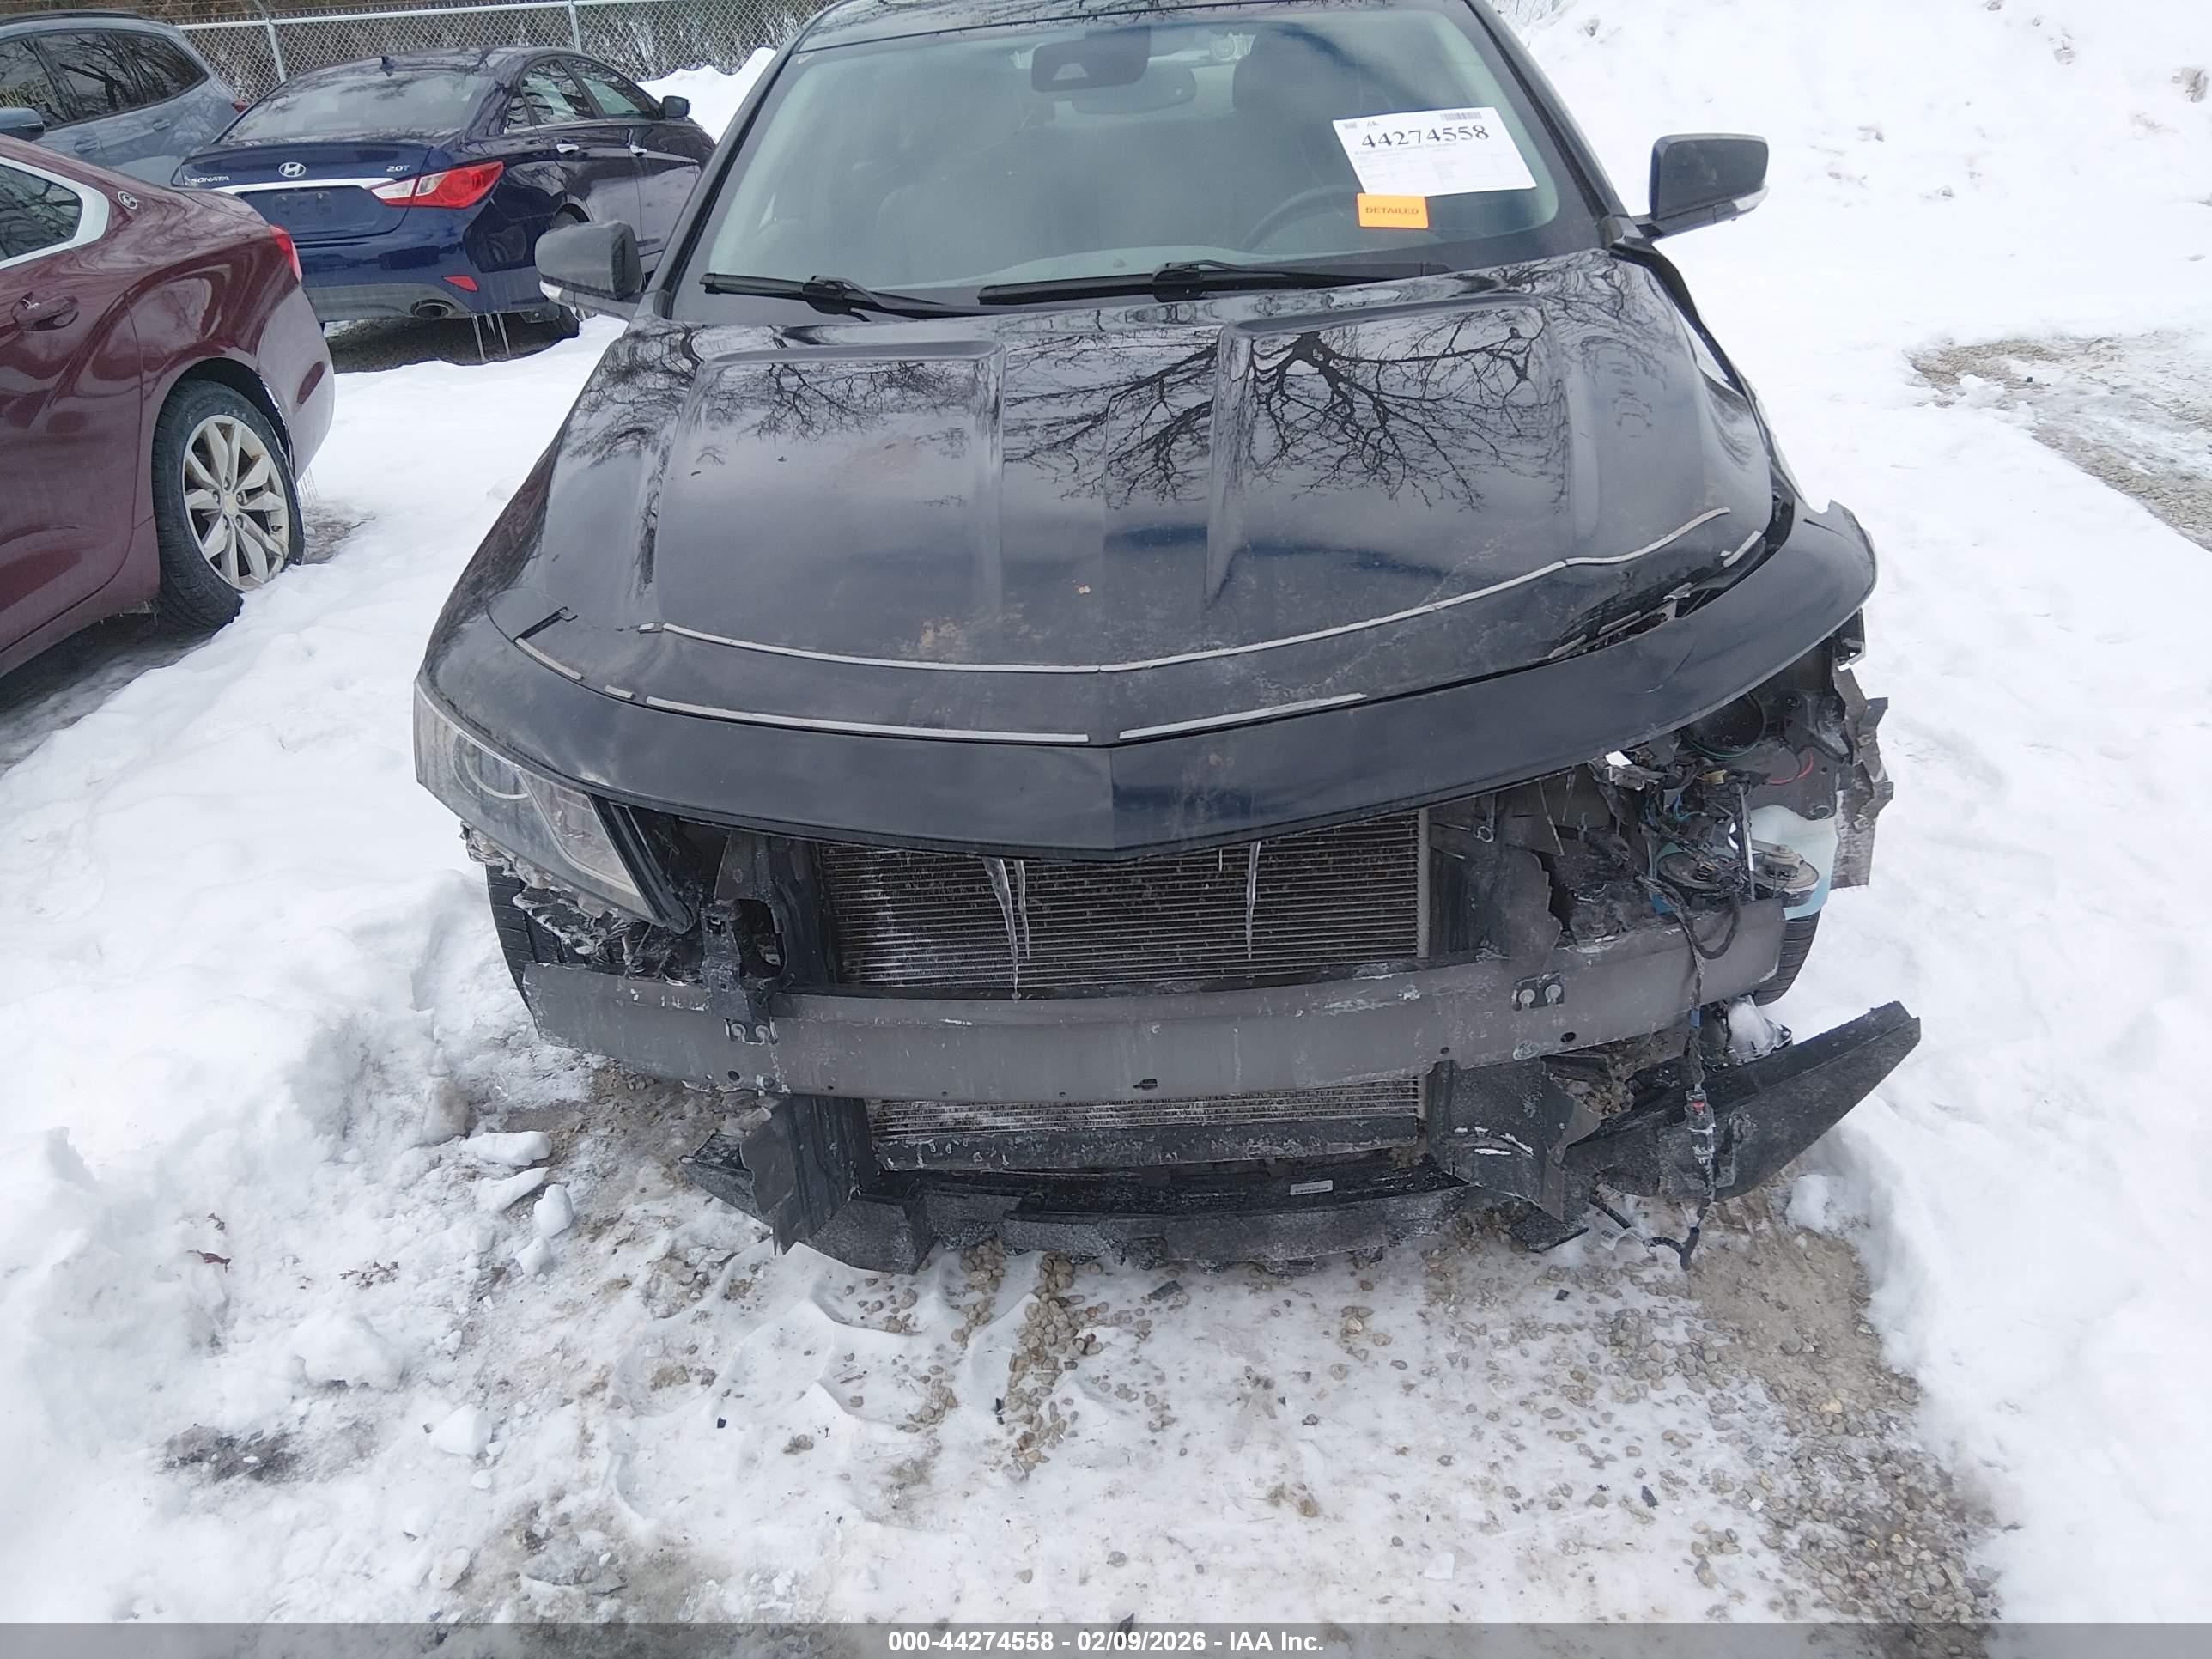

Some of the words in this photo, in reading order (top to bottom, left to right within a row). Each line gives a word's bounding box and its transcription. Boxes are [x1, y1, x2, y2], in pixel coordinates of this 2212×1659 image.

[1361, 124, 1490, 149] 44274558
[191, 175, 230, 184] SONATA
[1365, 206, 1419, 215] DETAILED
